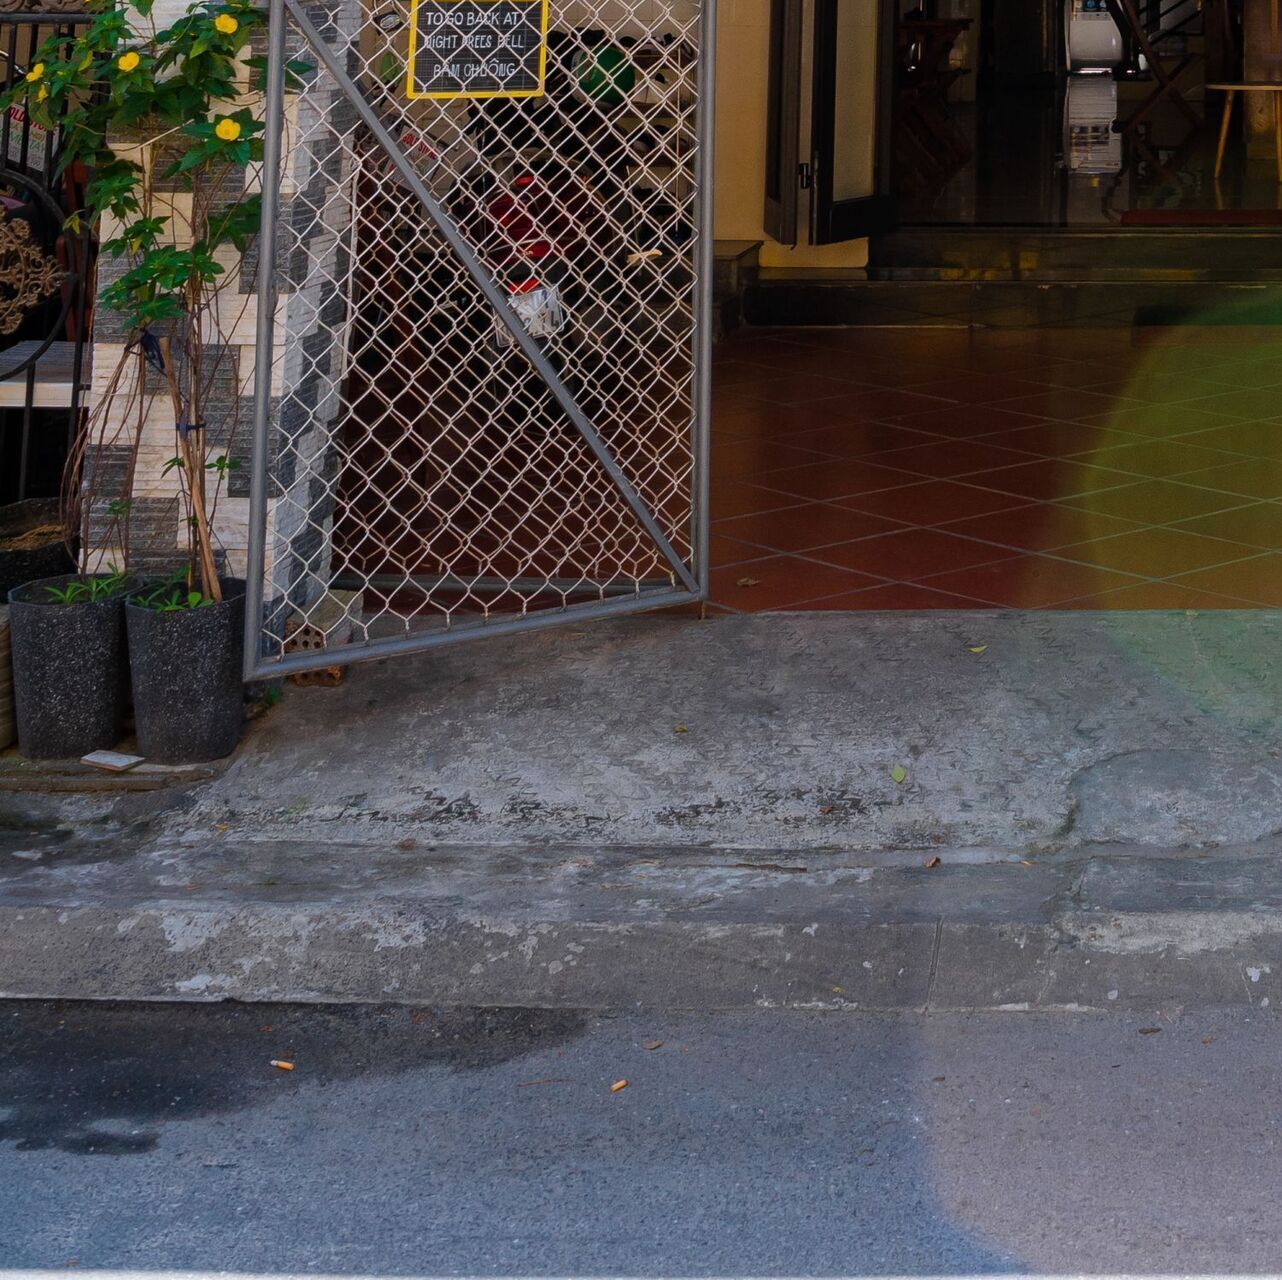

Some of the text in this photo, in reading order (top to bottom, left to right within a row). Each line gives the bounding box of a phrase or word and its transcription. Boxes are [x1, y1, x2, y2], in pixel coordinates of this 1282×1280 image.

[426, 12, 443, 26] TO
[466, 11, 500, 26] BACK
[503, 11, 519, 25] AT
